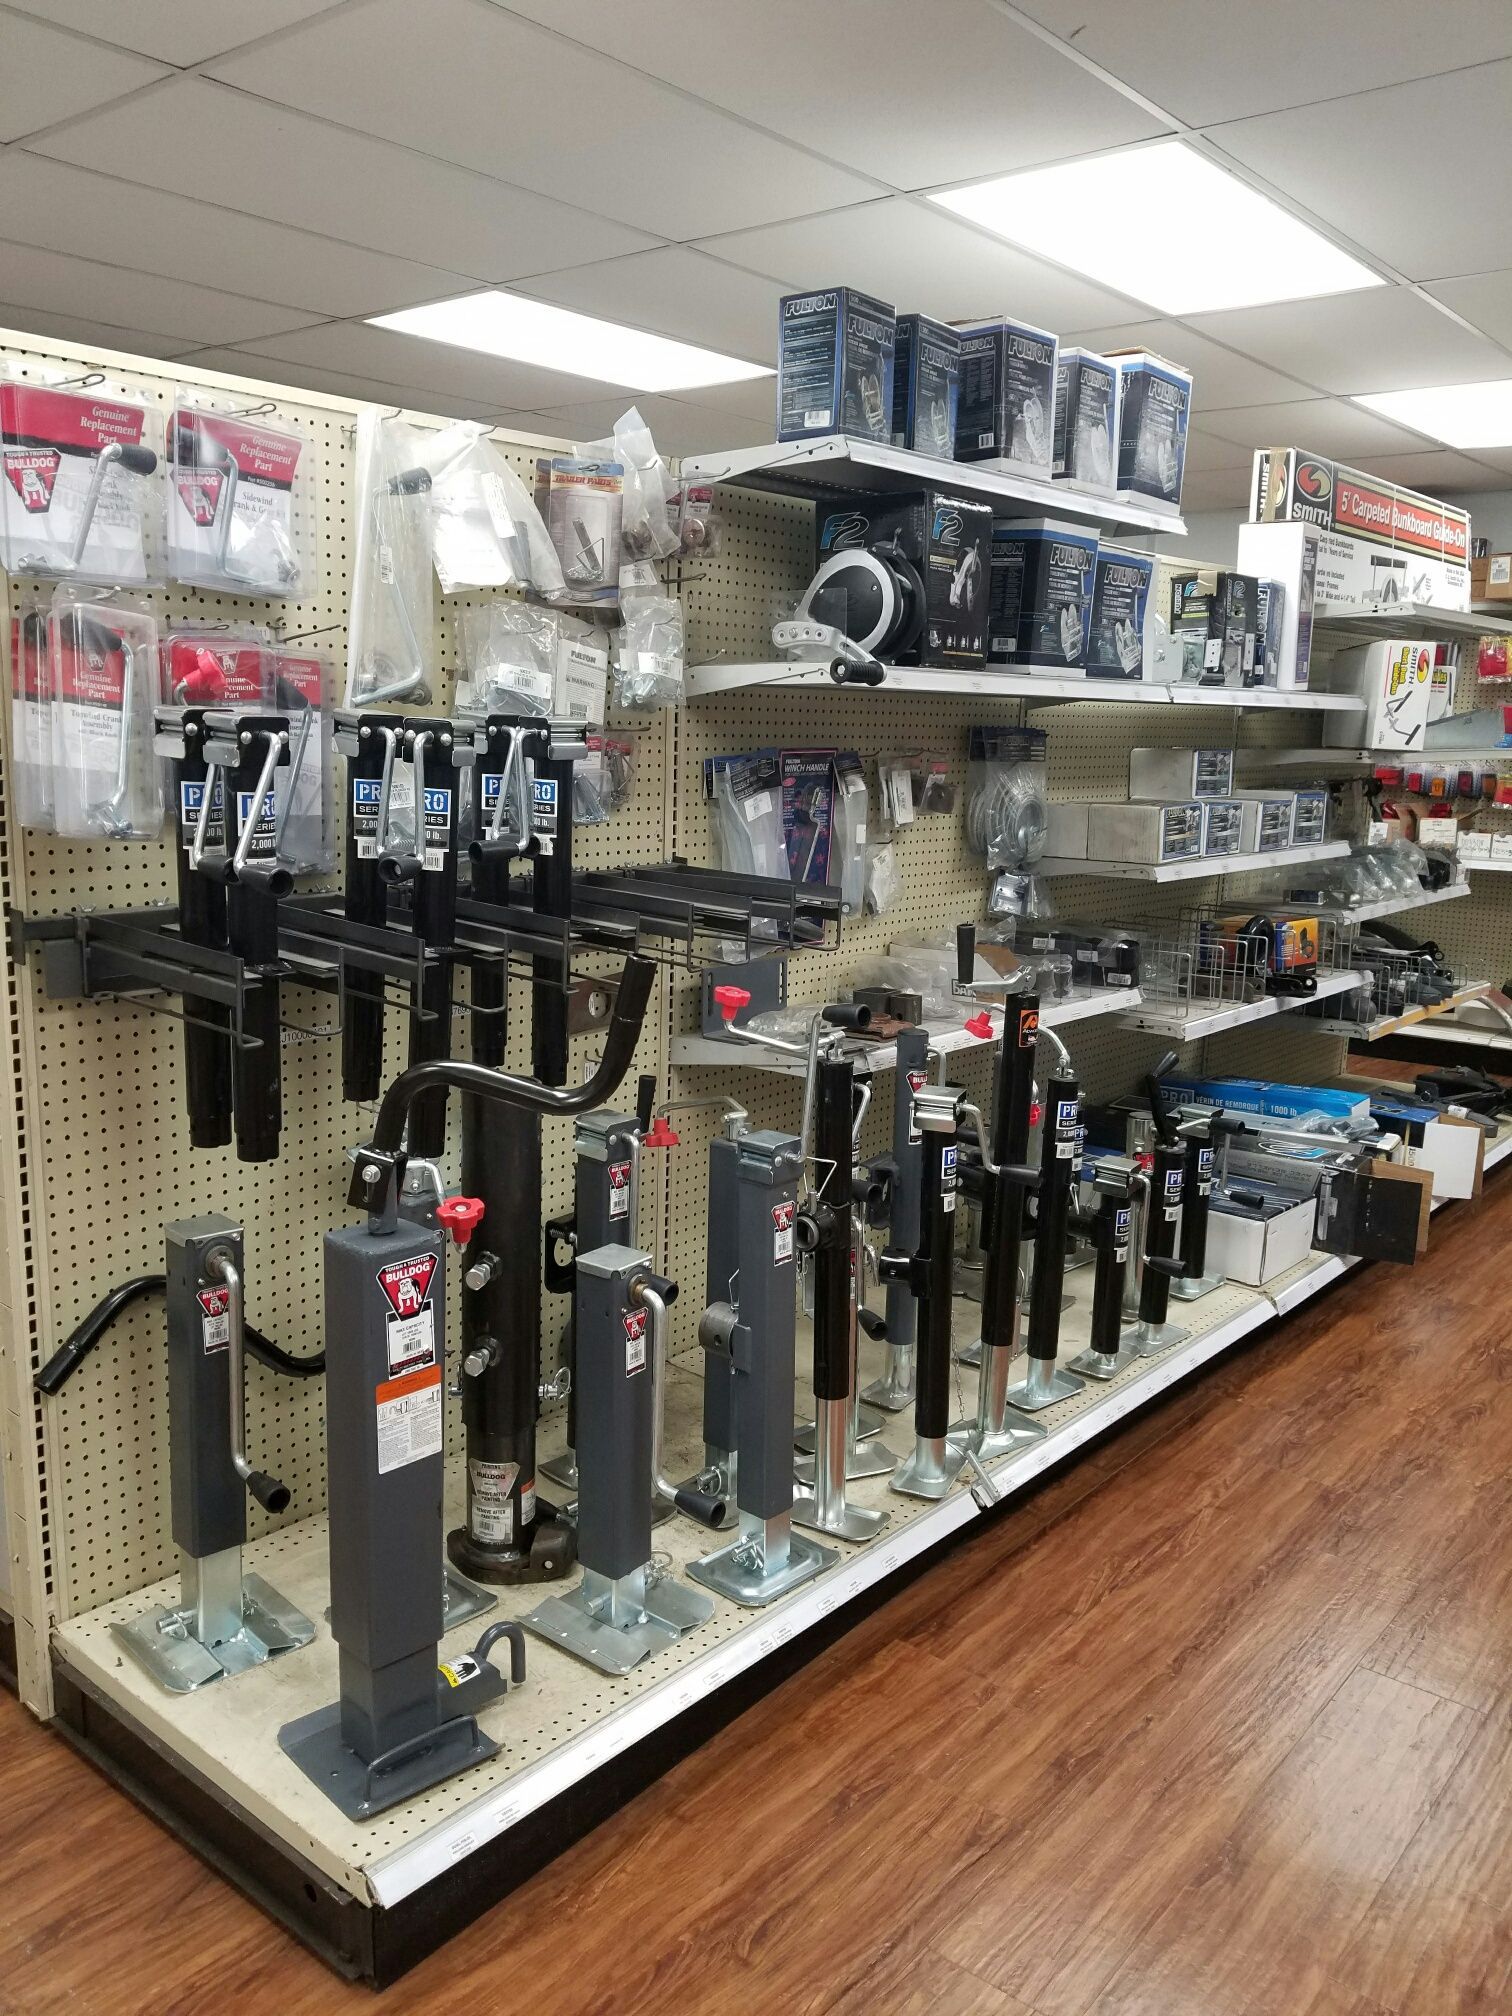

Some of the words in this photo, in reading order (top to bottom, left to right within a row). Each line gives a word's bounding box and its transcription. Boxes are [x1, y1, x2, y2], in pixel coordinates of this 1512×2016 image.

[784, 293, 837, 316] FULTON
[848, 314, 894, 347] FULTON
[960, 336, 994, 353] ULTON
[1008, 335, 1053, 366] FULTON
[921, 343, 959, 373] FULTON
[1081, 368, 1113, 391] FULTON
[1149, 377, 1187, 409] FULTON
[92, 406, 129, 422] Genuine
[80, 416, 137, 437] Replacement
[253, 436, 287, 452] Genuine
[240, 443, 291, 464] Replacement
[7, 457, 55, 468] BULLDOG
[255, 459, 272, 472] Part
[178, 477, 218, 486] BULLDOG
[556, 474, 585, 483] TRAILER
[588, 476, 612, 486] PARTS
[234, 500, 250, 510] rank
[243, 492, 272, 506] Sidewind
[932, 508, 964, 546] F2
[1352, 493, 1390, 524] Carpeted
[1392, 508, 1432, 538] Bunkboard
[1434, 521, 1466, 550] Guide-On
[820, 512, 870, 550] F2
[1320, 534, 1335, 546] Carpted
[1050, 544, 1094, 571] FULTON
[1104, 564, 1147, 588] FULTON
[1257, 588, 1270, 646] FULTON
[571, 650, 596, 664] FULTON
[1409, 647, 1418, 684] SMITH
[80, 672, 112, 683] Genuine
[572, 677, 594, 688] WARNING
[73, 679, 120, 693] Replacement
[88, 689, 106, 699] Part
[82, 720, 112, 730] Assembly
[102, 714, 121, 723] Cran
[784, 764, 806, 772] WINCH
[806, 763, 829, 771] HANDLE
[189, 788, 222, 805] PO
[360, 784, 380, 799] PR
[534, 784, 551, 799] RO
[425, 793, 444, 810] RO
[362, 820, 377, 829] 2,00
[433, 831, 441, 840] lb.
[252, 839, 271, 849] 2,000
[1162, 1088, 1188, 1104] PRO
[1063, 1105, 1077, 1116] PR
[1225, 1100, 1259, 1110] REMORQUE
[1271, 1105, 1288, 1114] 1000
[1290, 1107, 1297, 1116] lb
[1074, 1128, 1084, 1138] PR
[948, 1152, 956, 1164] PR
[1204, 1151, 1214, 1162] PR
[1170, 1174, 1182, 1184] PR
[1120, 1212, 1130, 1224] PR
[385, 1263, 403, 1273] TOUGH
[407, 1256, 430, 1266] TRUSTED
[386, 1262, 431, 1283] BULLDOG
